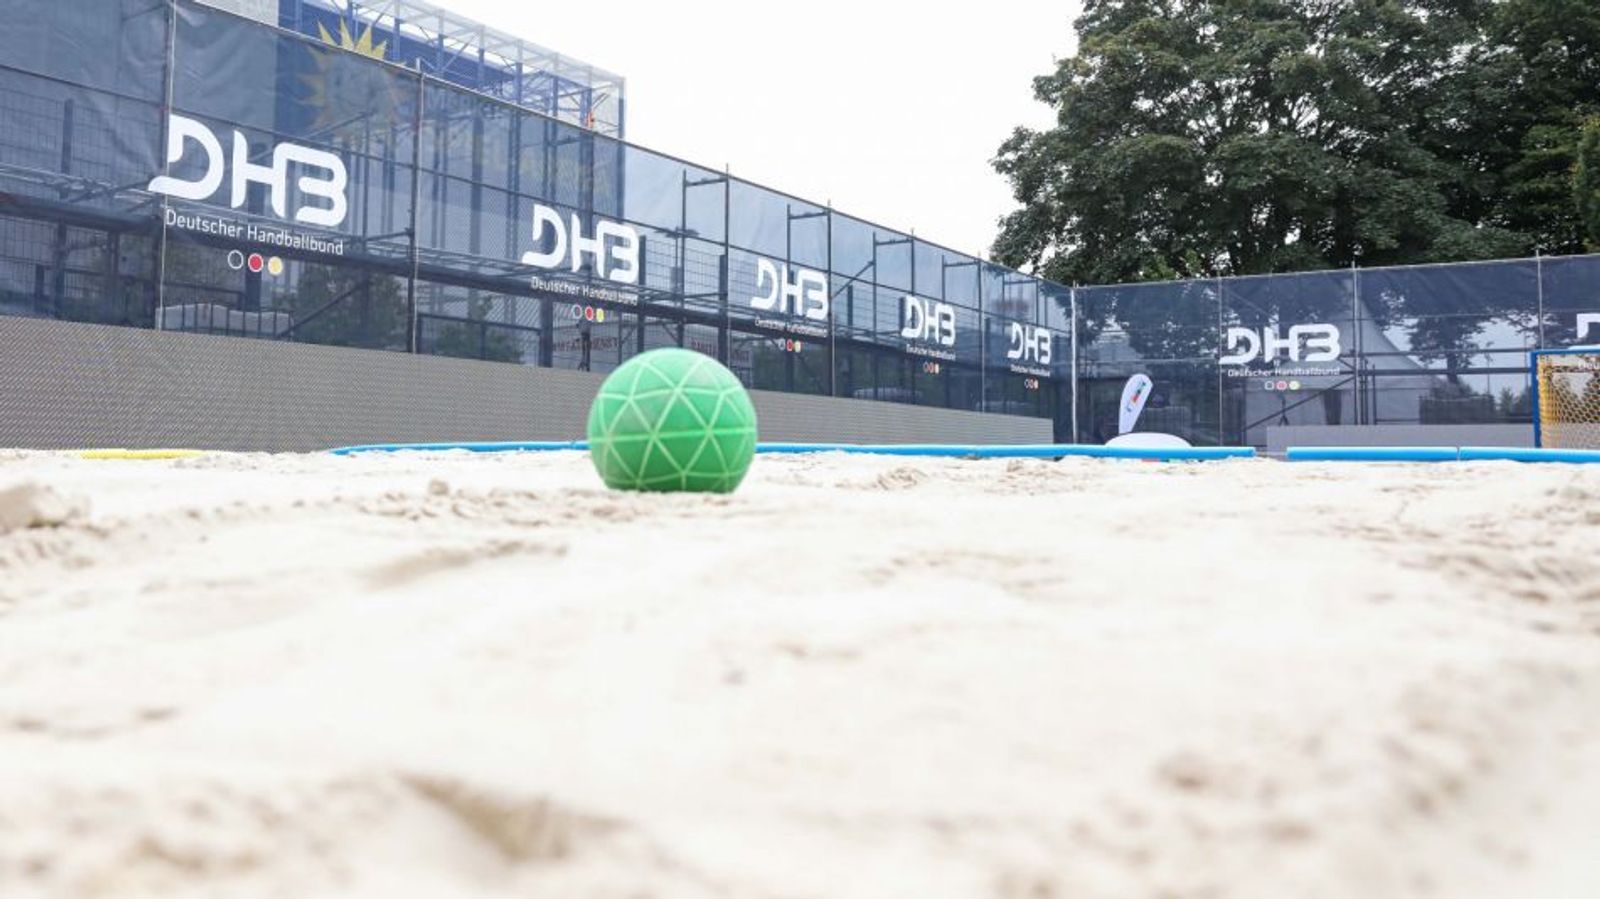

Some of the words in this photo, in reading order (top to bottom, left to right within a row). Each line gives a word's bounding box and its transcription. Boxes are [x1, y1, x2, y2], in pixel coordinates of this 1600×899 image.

[148, 114, 347, 226] DHB
[166, 209, 243, 238] Deutscher
[247, 226, 344, 255] Handballbund
[522, 203, 639, 283] DHB
[531, 276, 579, 295] Deutscher
[750, 257, 828, 320] DHB
[901, 296, 955, 345] DHB
[1007, 322, 1051, 364] DHB
[1218, 324, 1340, 364] DHB
[1228, 368, 1272, 377] Deutscher
